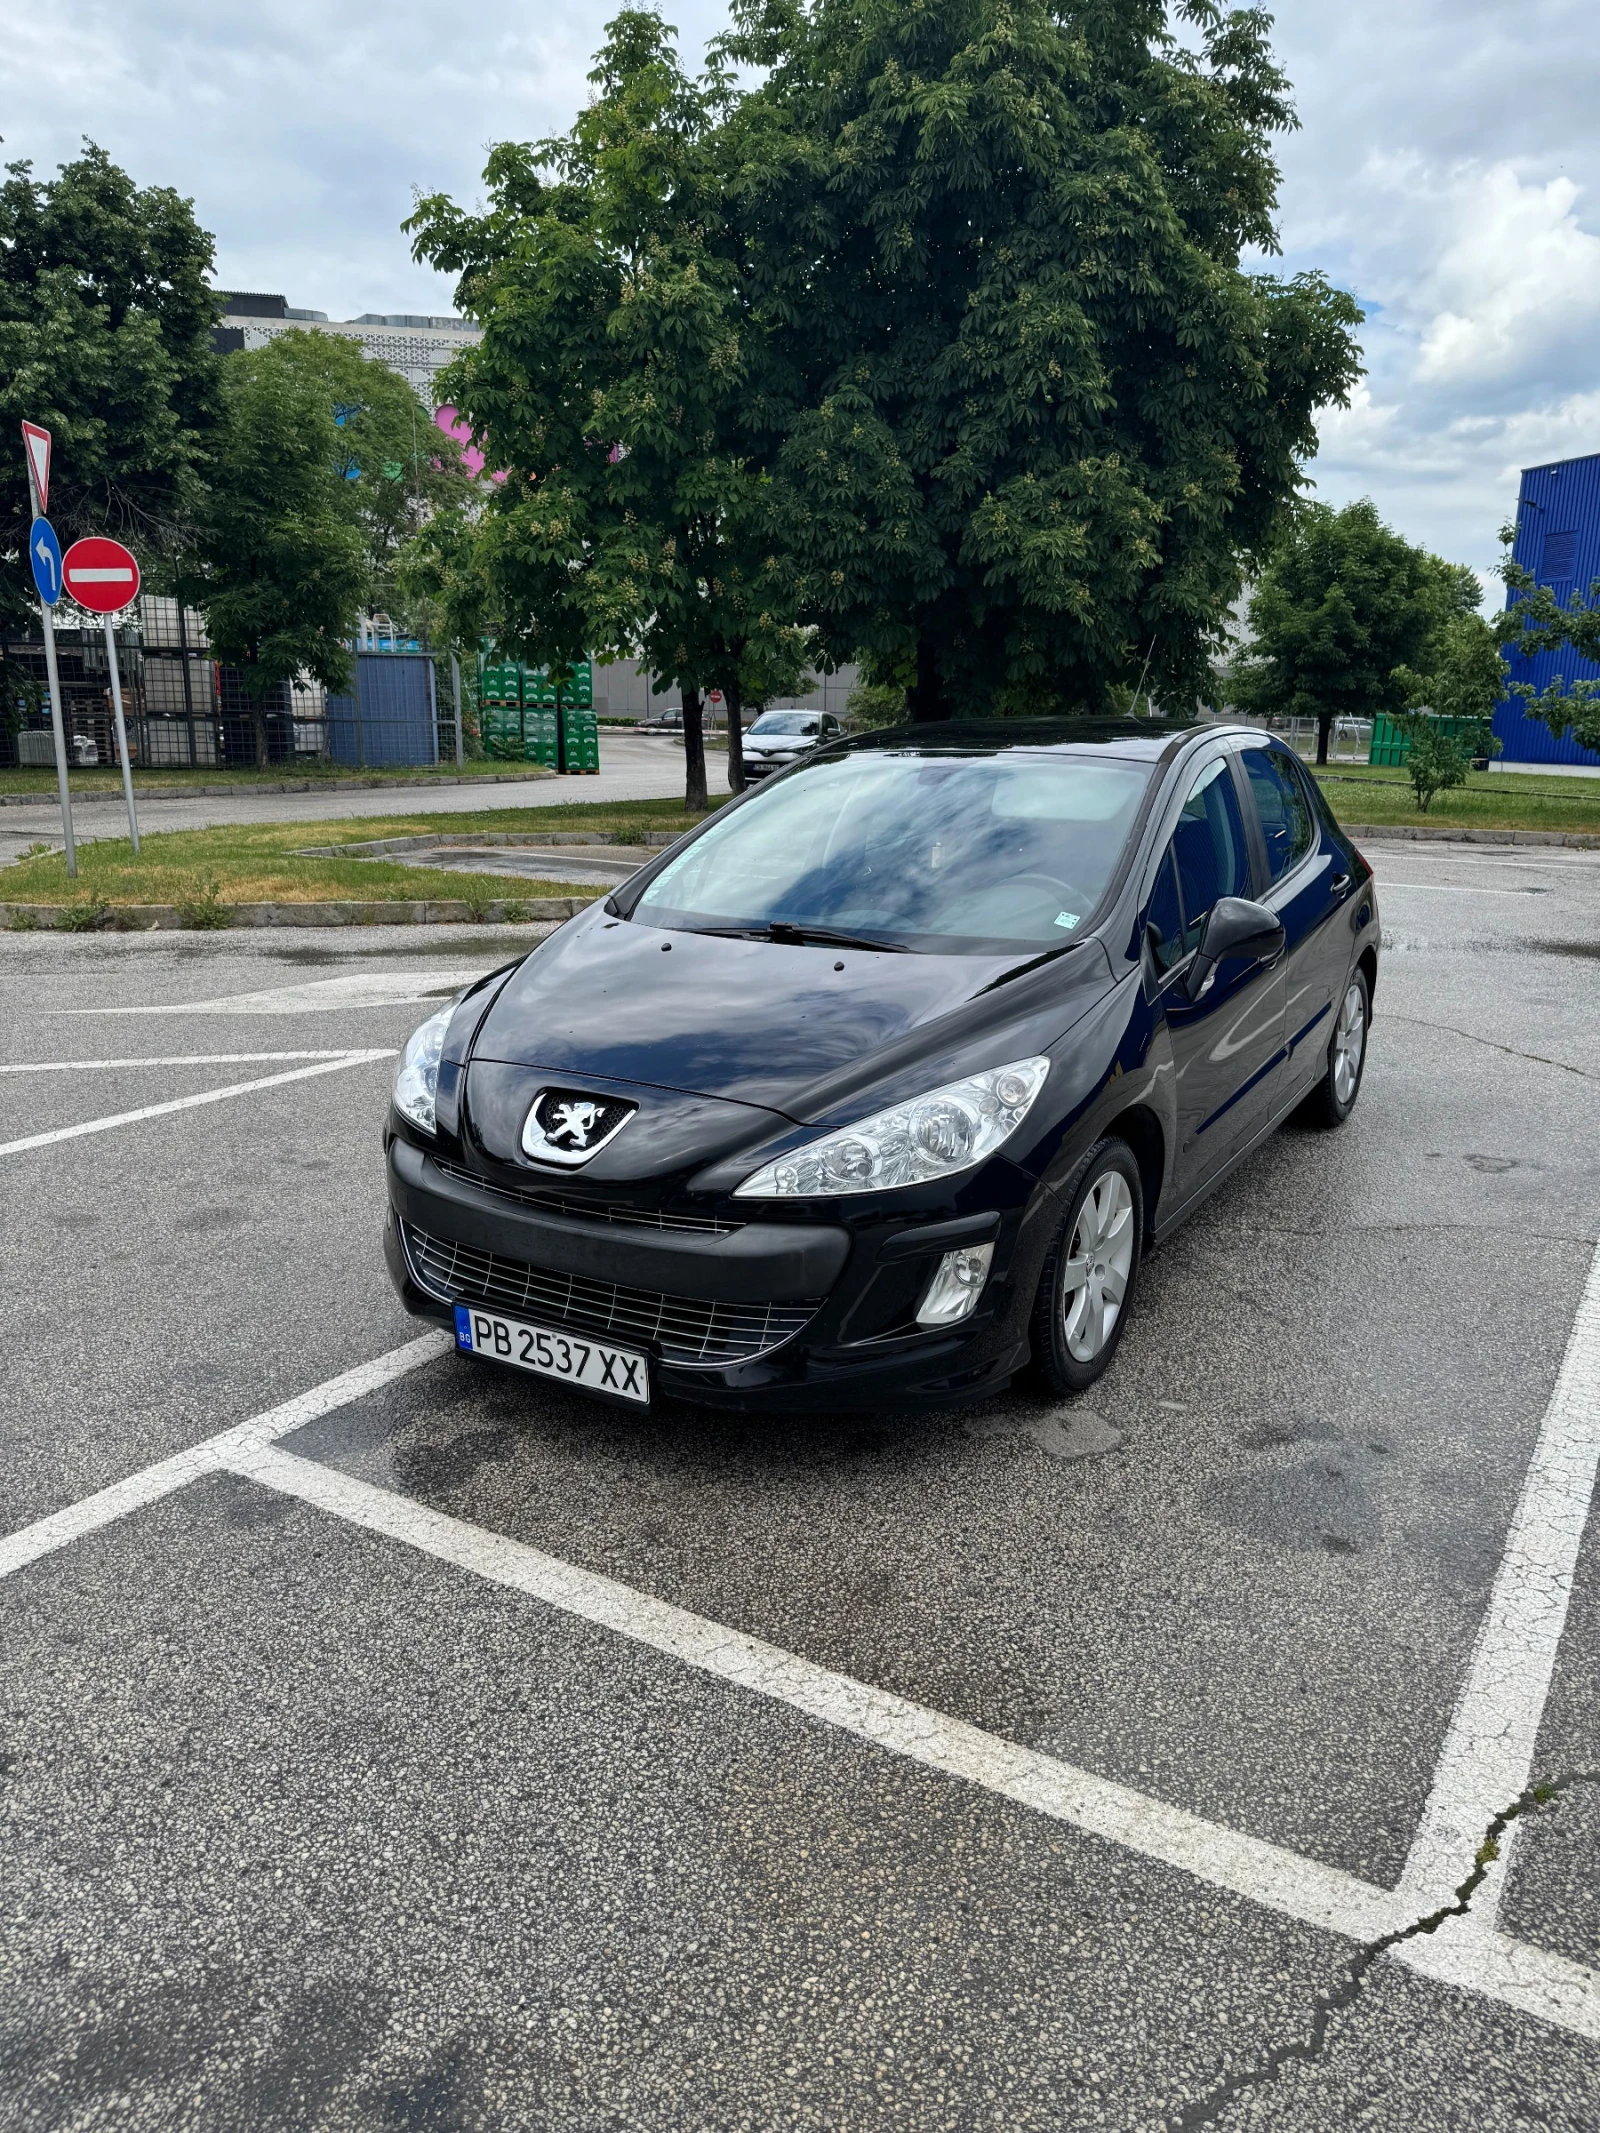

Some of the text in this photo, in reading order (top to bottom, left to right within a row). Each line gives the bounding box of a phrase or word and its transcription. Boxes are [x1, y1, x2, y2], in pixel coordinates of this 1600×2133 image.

[459, 1331, 471, 1344] BG
[474, 1315, 641, 1395] PB 2537 XX
